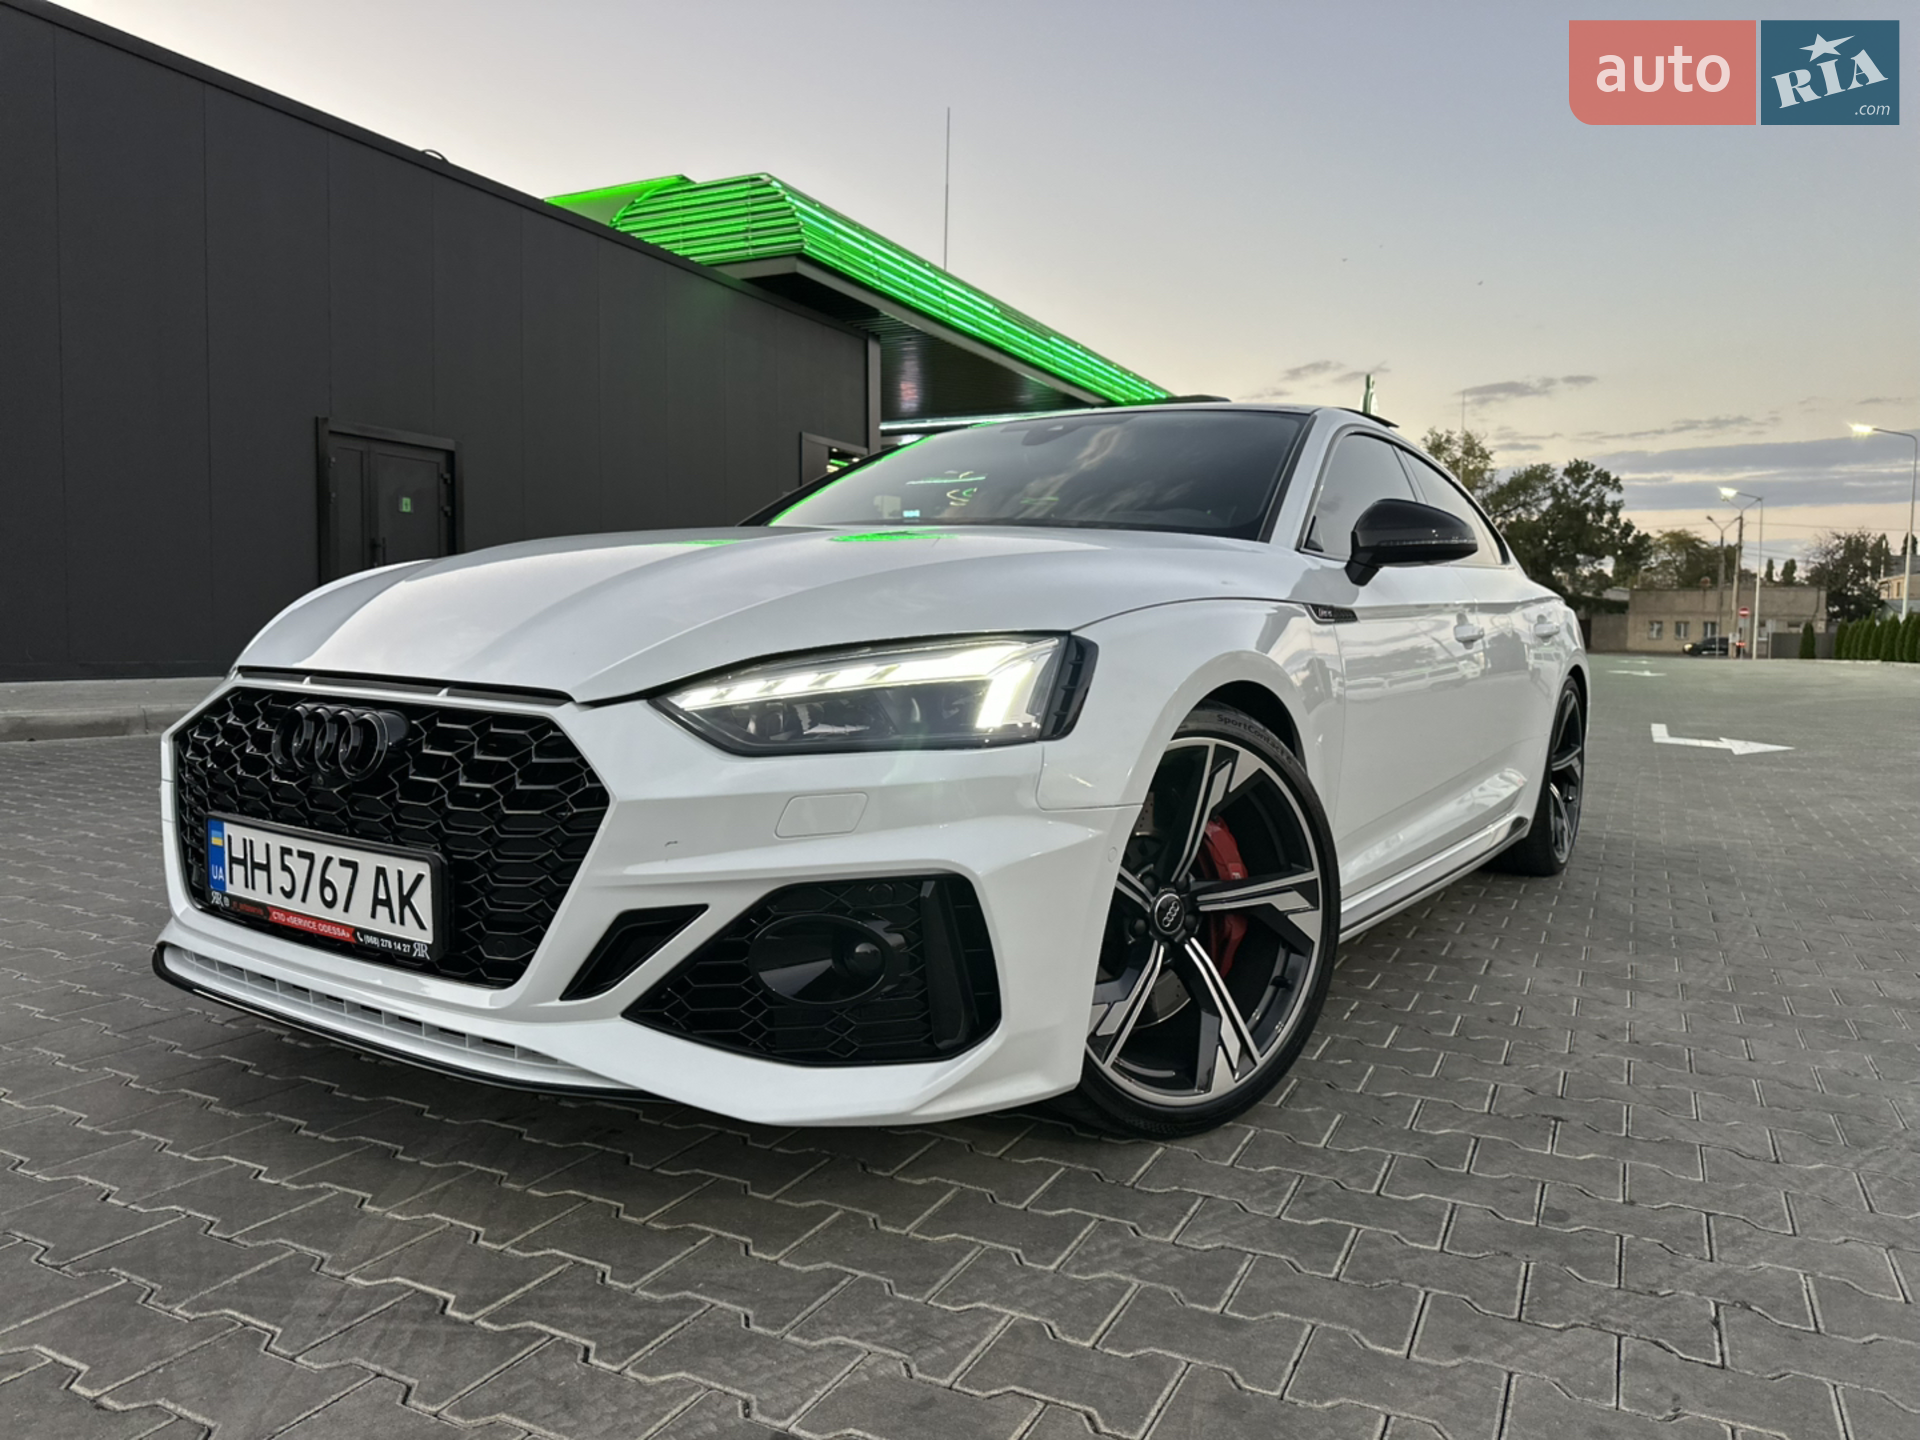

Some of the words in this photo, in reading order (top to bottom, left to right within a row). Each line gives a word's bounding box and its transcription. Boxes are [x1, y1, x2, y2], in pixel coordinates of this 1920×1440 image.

[1217, 714, 1284, 756] SportContact
[212, 864, 225, 881] UA
[228, 834, 272, 895] HH
[279, 846, 359, 914] 5767
[370, 865, 428, 930] AK
[380, 938, 392, 949] 278
[393, 941, 402, 951] 14
[402, 943, 411, 953] 27
